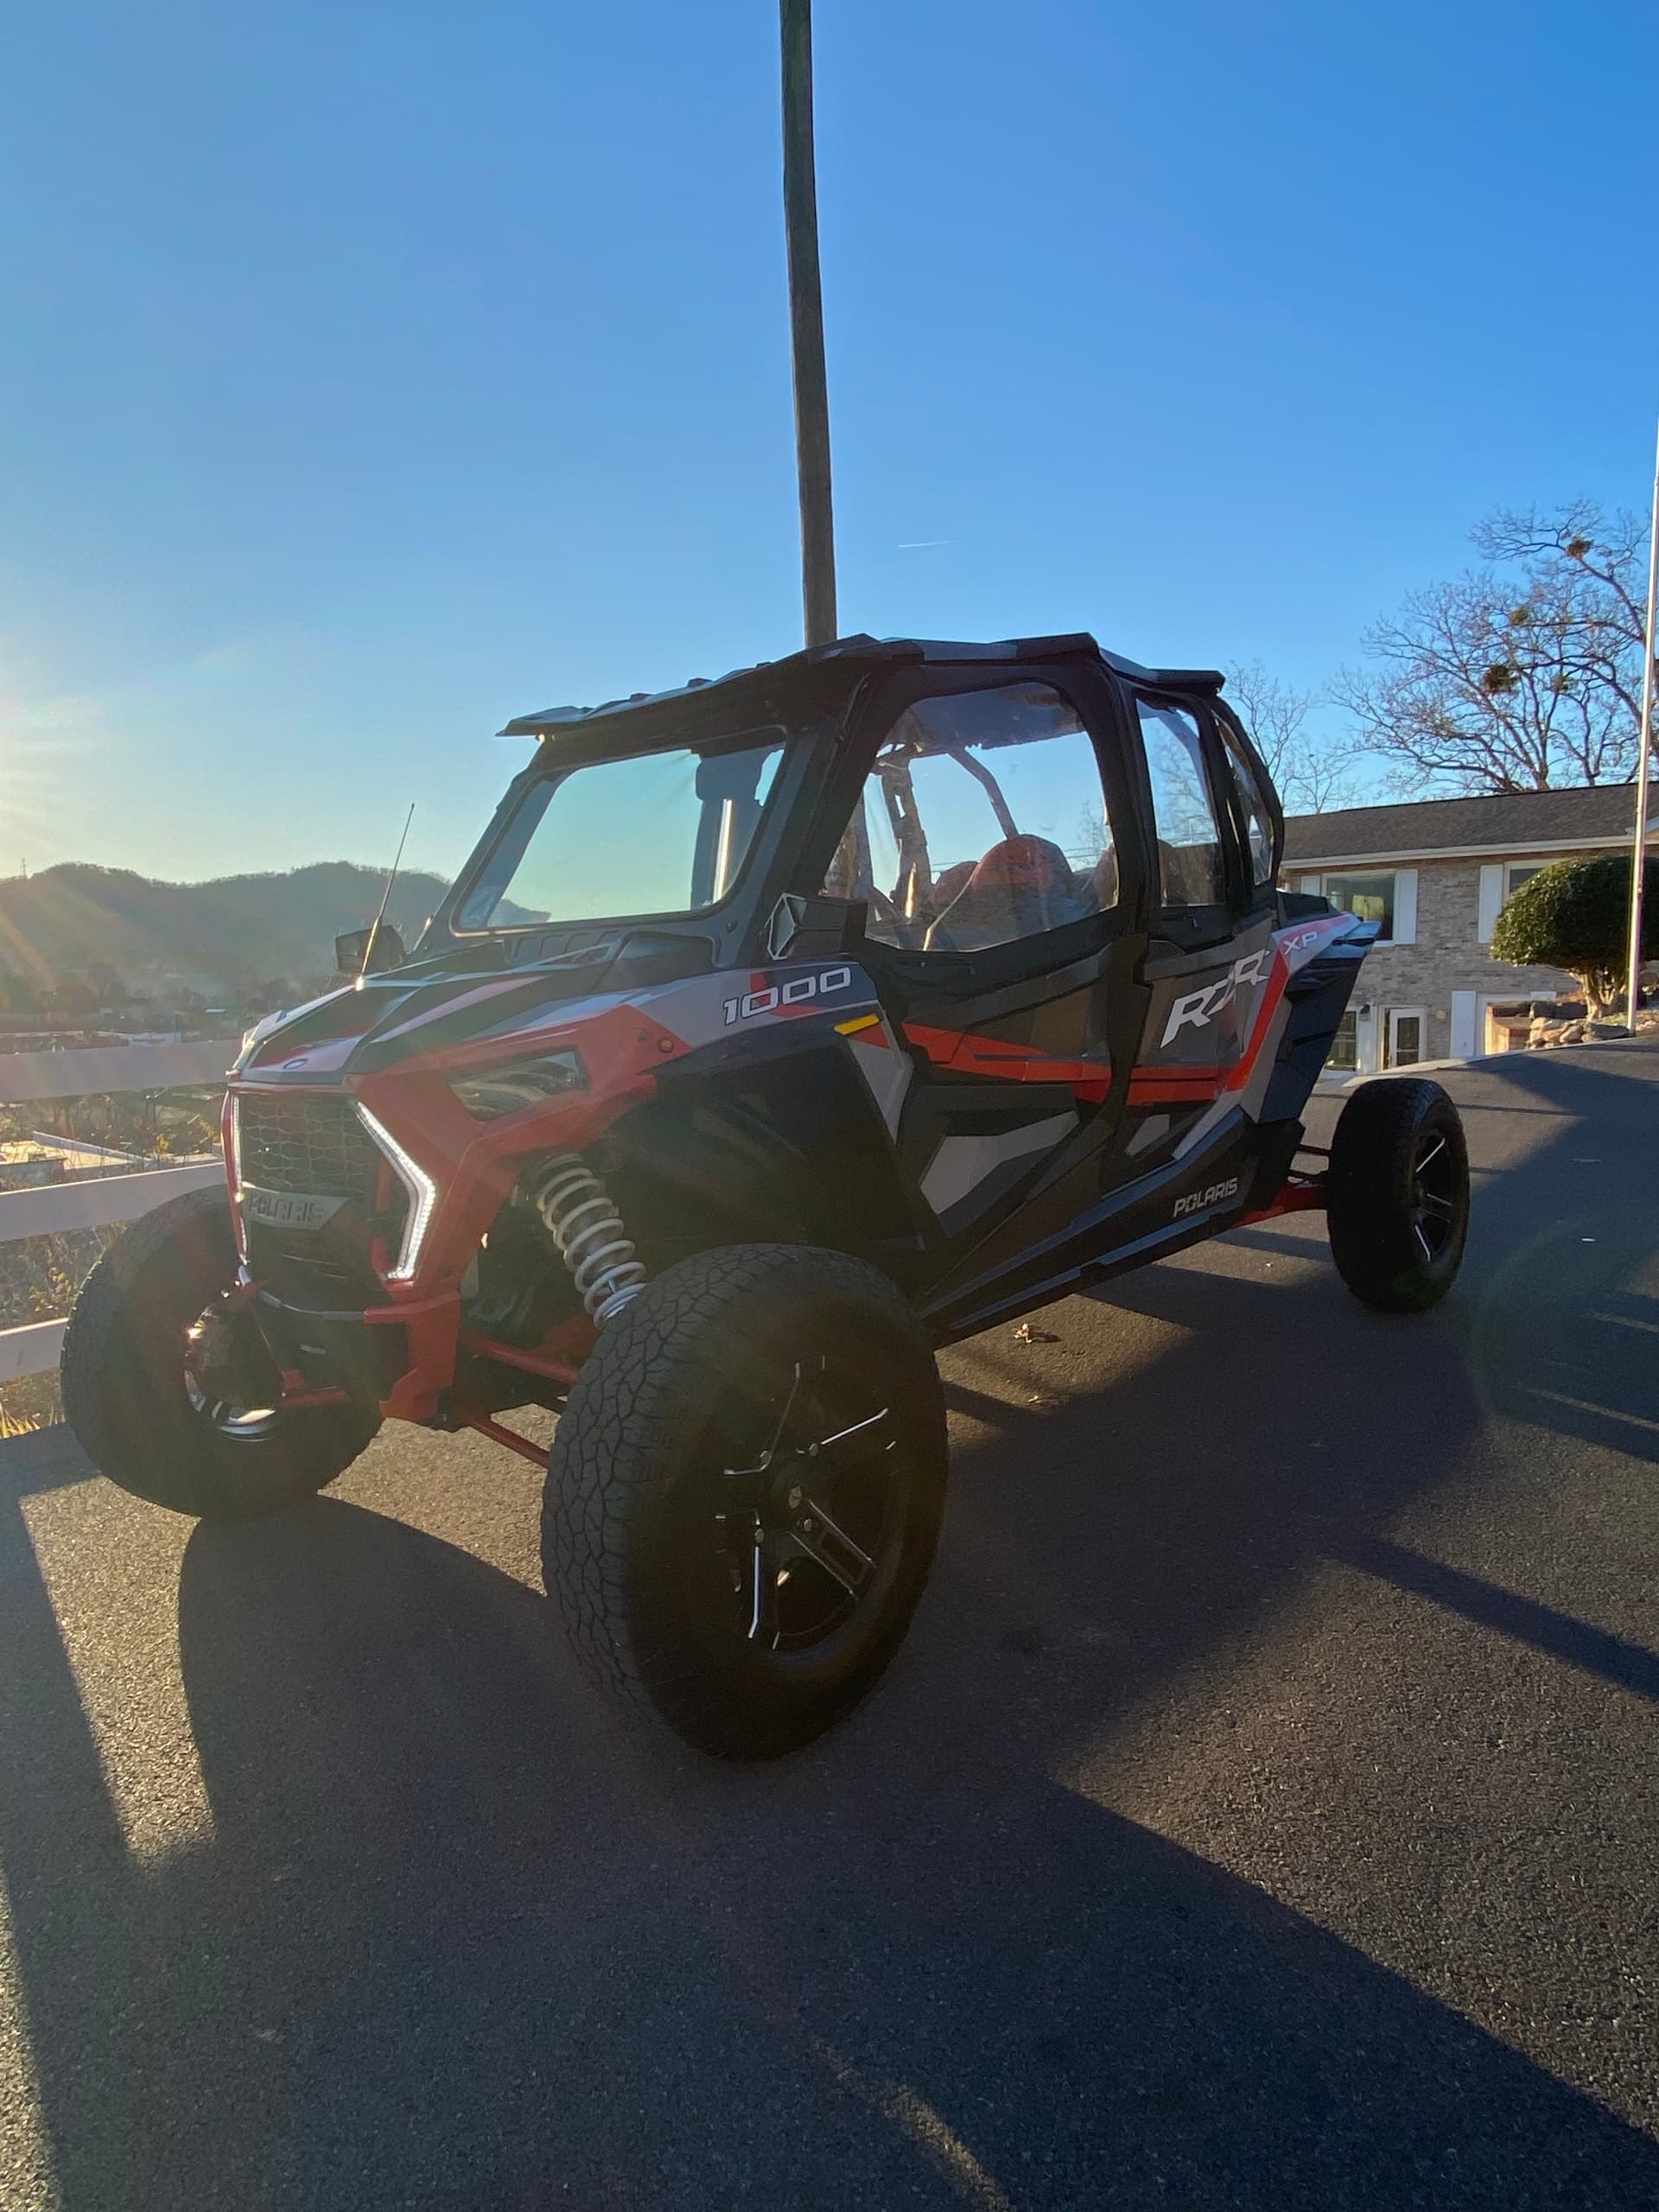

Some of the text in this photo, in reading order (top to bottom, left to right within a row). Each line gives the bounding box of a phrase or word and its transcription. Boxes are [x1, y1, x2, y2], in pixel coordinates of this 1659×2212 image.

[1283, 931, 1318, 955] XP
[723, 967, 851, 1025] 1000
[1160, 949, 1271, 1048] RZR
[248, 1195, 323, 1222] POLARIS
[1173, 1177, 1238, 1217] POLARIS
